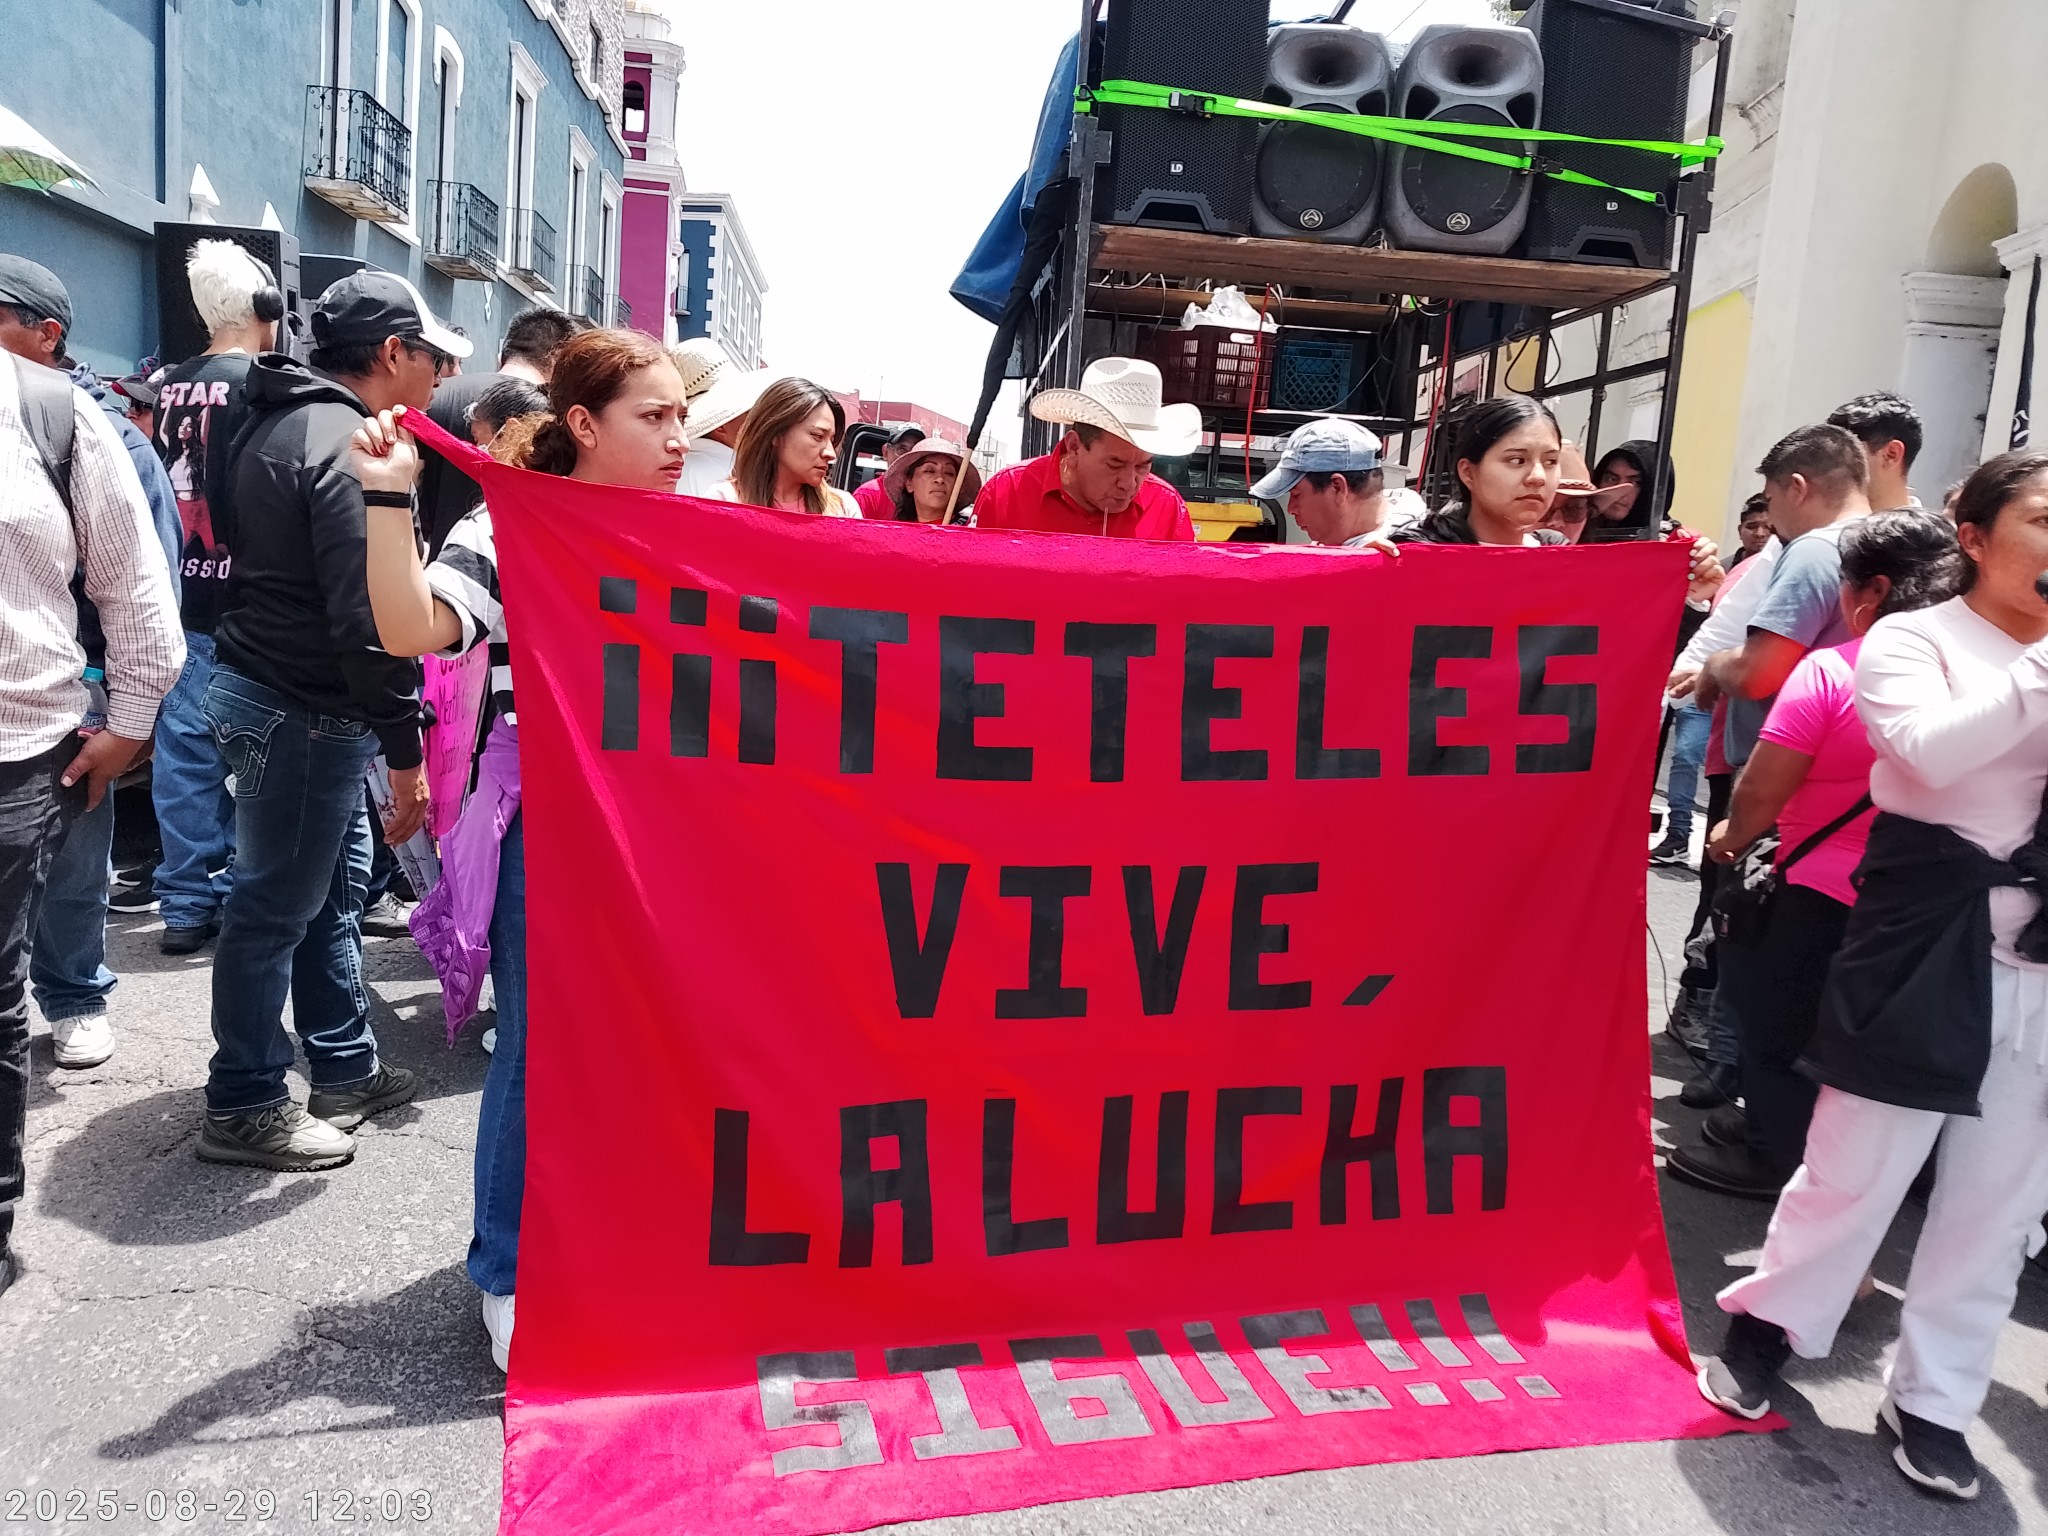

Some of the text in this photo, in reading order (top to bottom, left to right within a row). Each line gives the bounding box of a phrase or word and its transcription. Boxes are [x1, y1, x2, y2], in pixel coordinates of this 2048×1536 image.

[1170, 163, 1184, 173] LD
[1606, 201, 1619, 211] LD
[160, 381, 230, 410] STAR
[875, 862, 1396, 1019] VIVE,
[709, 1066, 1507, 1269] LA LUCHA
[757, 1292, 1562, 1477] SIGUE!!!
